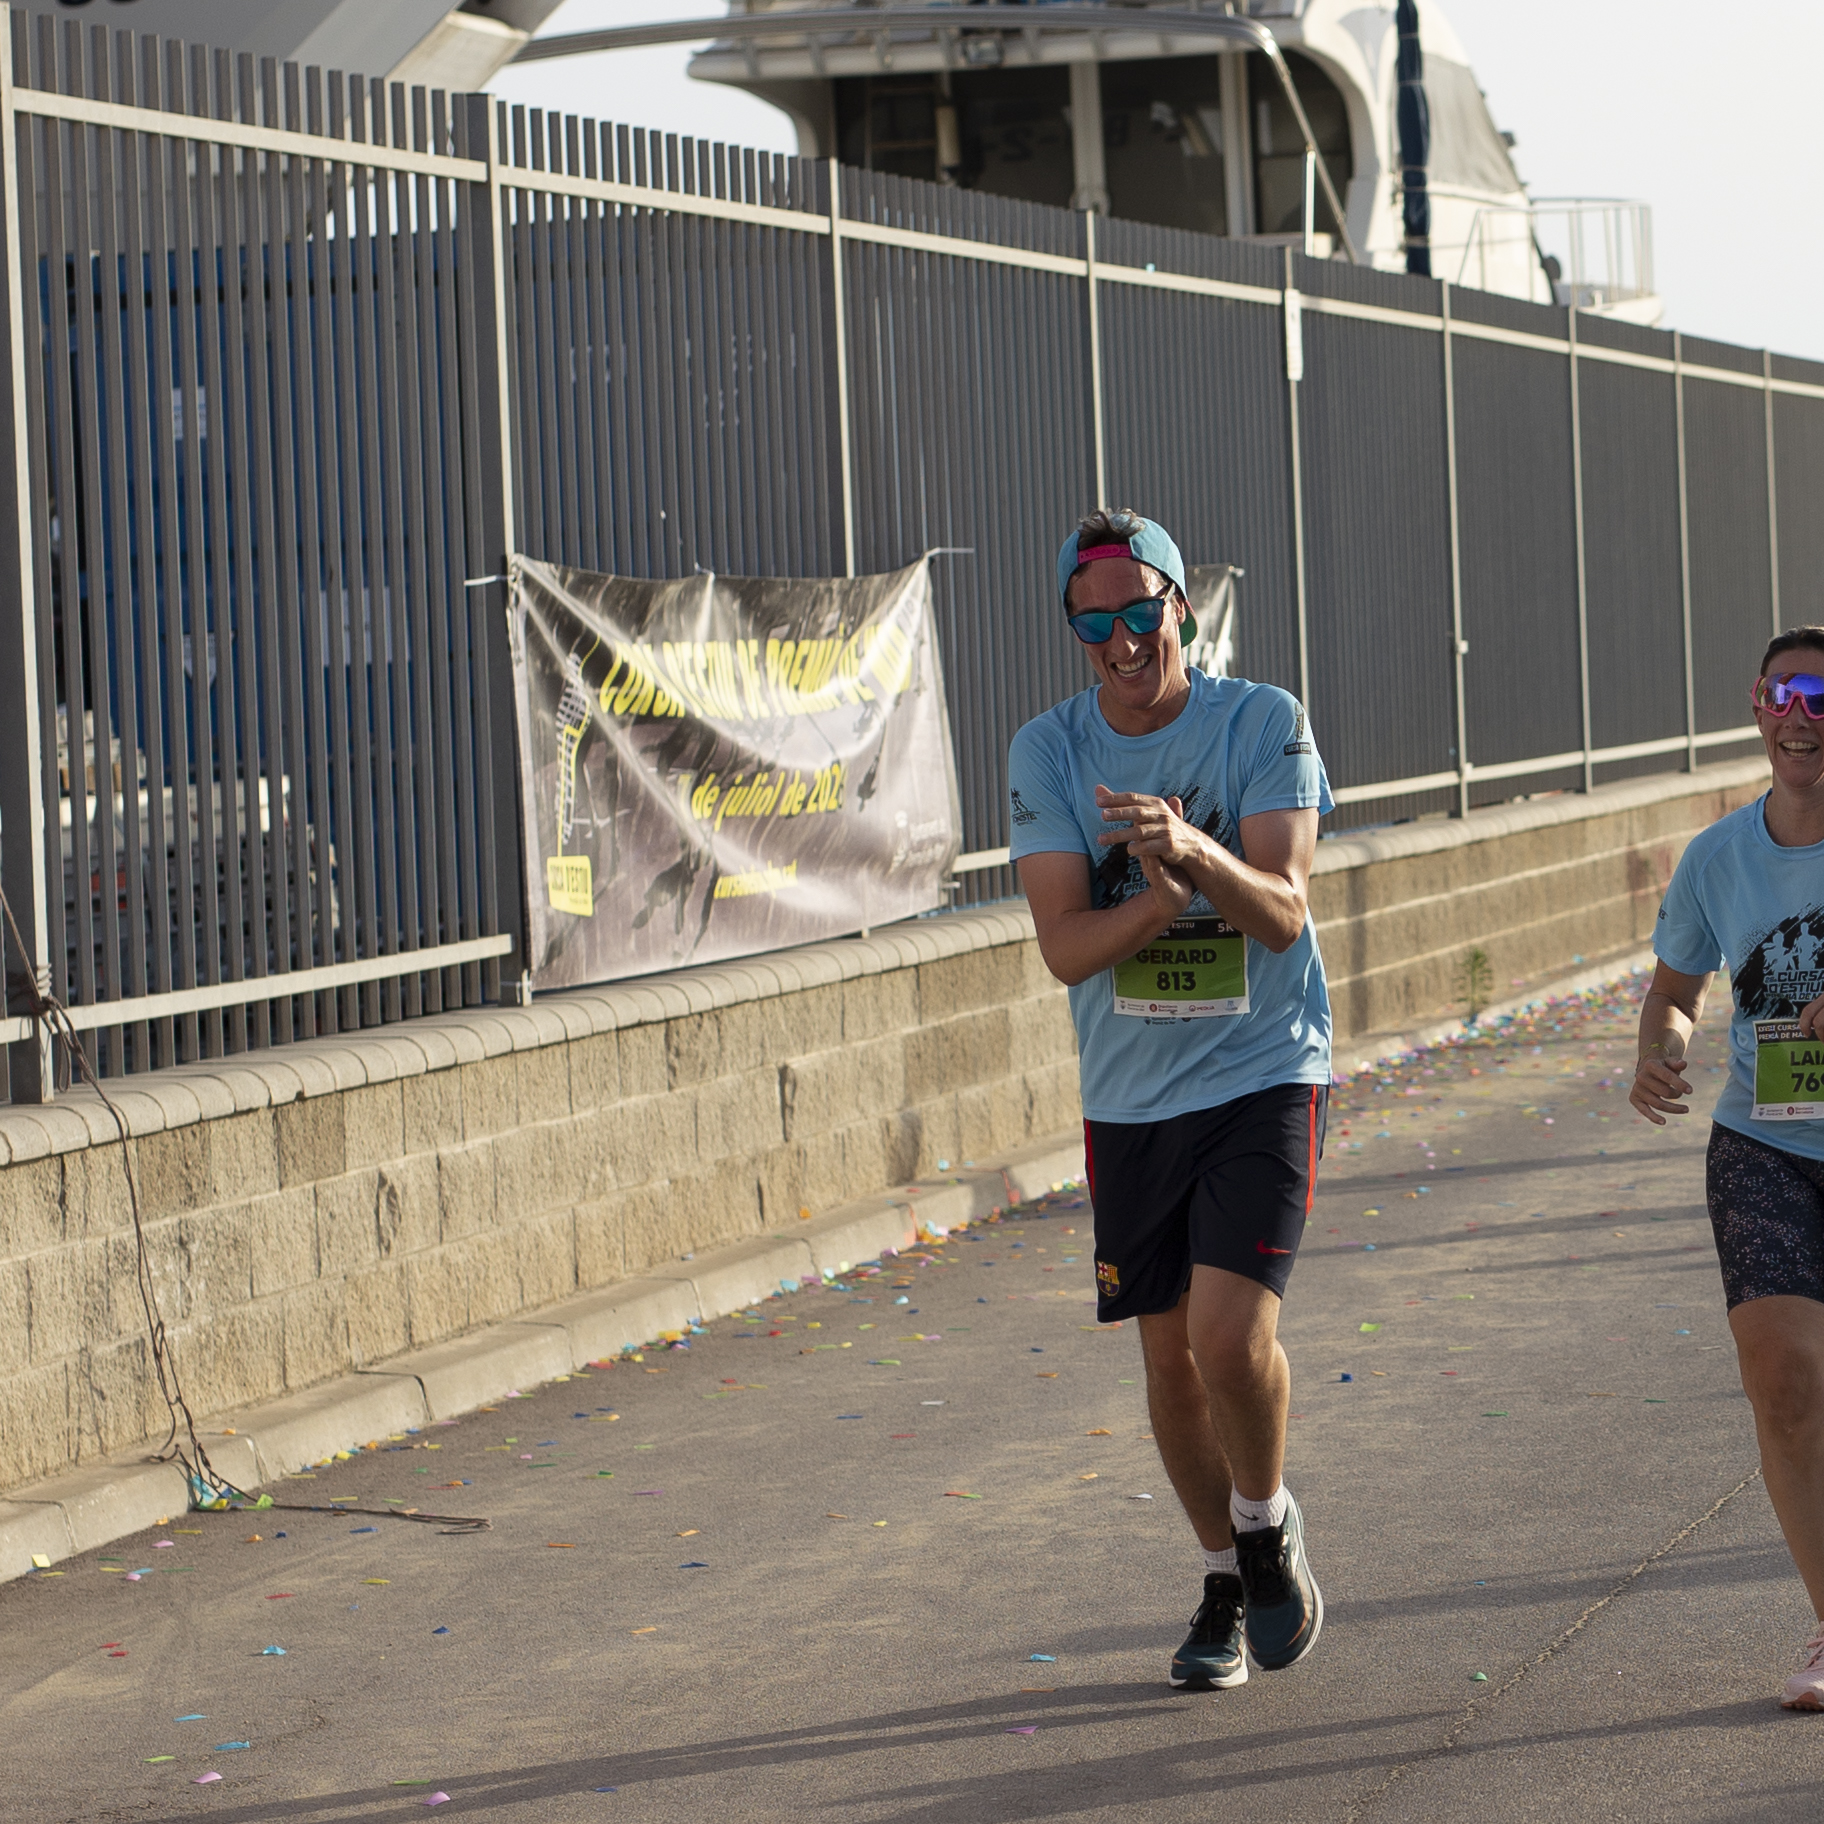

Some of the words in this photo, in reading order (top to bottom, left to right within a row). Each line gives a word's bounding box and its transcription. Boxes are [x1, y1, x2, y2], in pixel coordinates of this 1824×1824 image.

[691, 772, 721, 820] de
[713, 770, 786, 832] juliol
[778, 768, 807, 816] de
[805, 762, 847, 814] 202
[1135, 948, 1218, 965] GERARD
[1156, 971, 1197, 991] 813
[1792, 1031, 1806, 1039] MA
